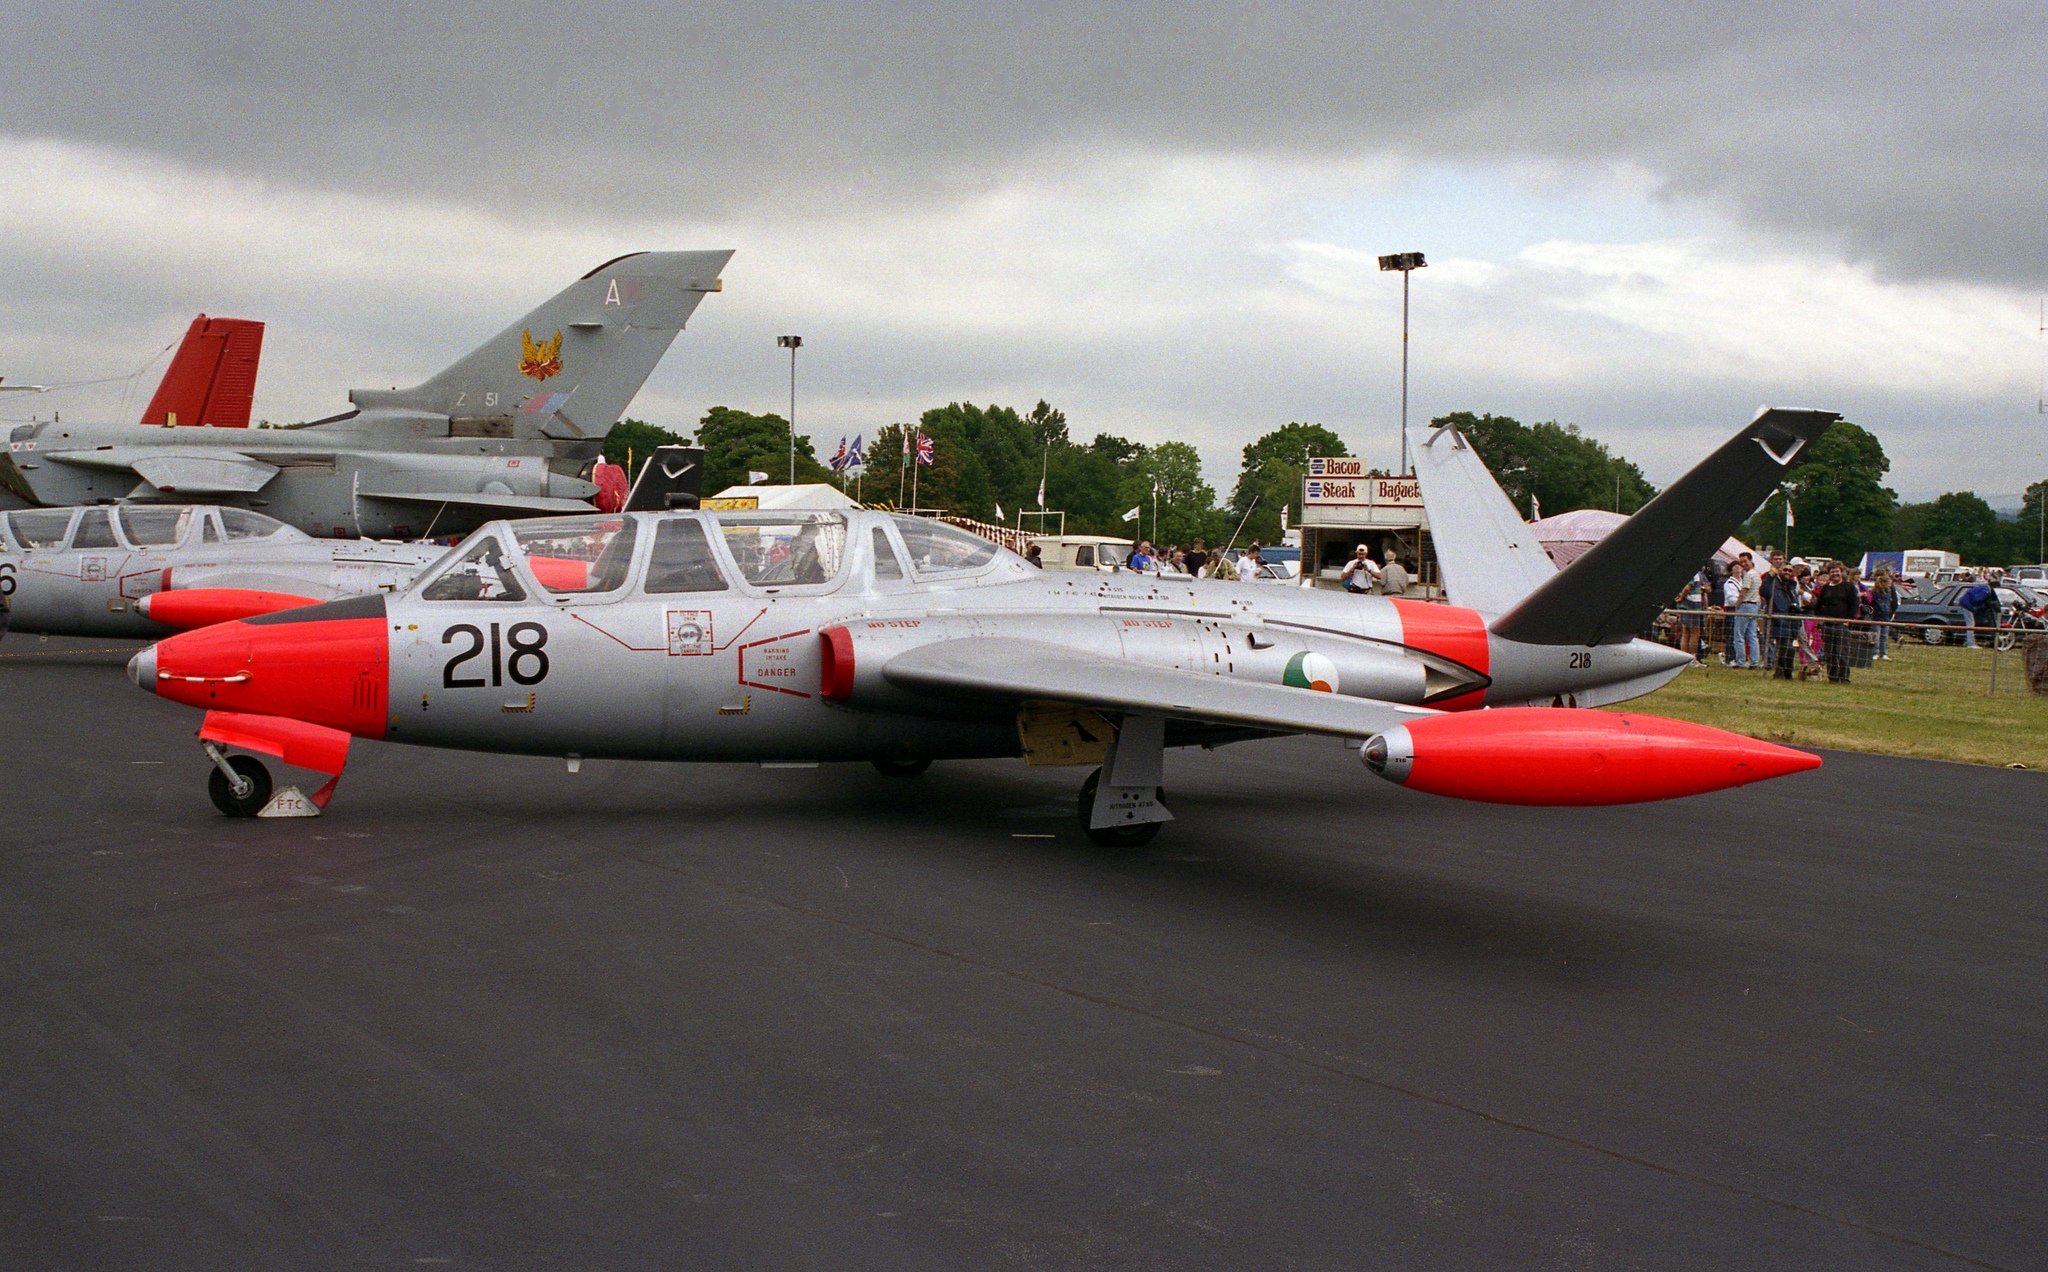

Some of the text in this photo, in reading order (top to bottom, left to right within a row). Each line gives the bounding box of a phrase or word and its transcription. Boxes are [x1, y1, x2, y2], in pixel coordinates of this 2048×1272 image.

[605, 279, 621, 306] A
[485, 392, 499, 407] 51
[1326, 458, 1361, 475] Bacon
[1322, 480, 1422, 502] Steak Baguet
[887, 620, 921, 628] STEP
[1141, 620, 1173, 628] STEP
[441, 621, 550, 689] 218
[1569, 652, 1592, 669] 218
[757, 668, 797, 677] DANGER
[276, 799, 303, 810] FTC
